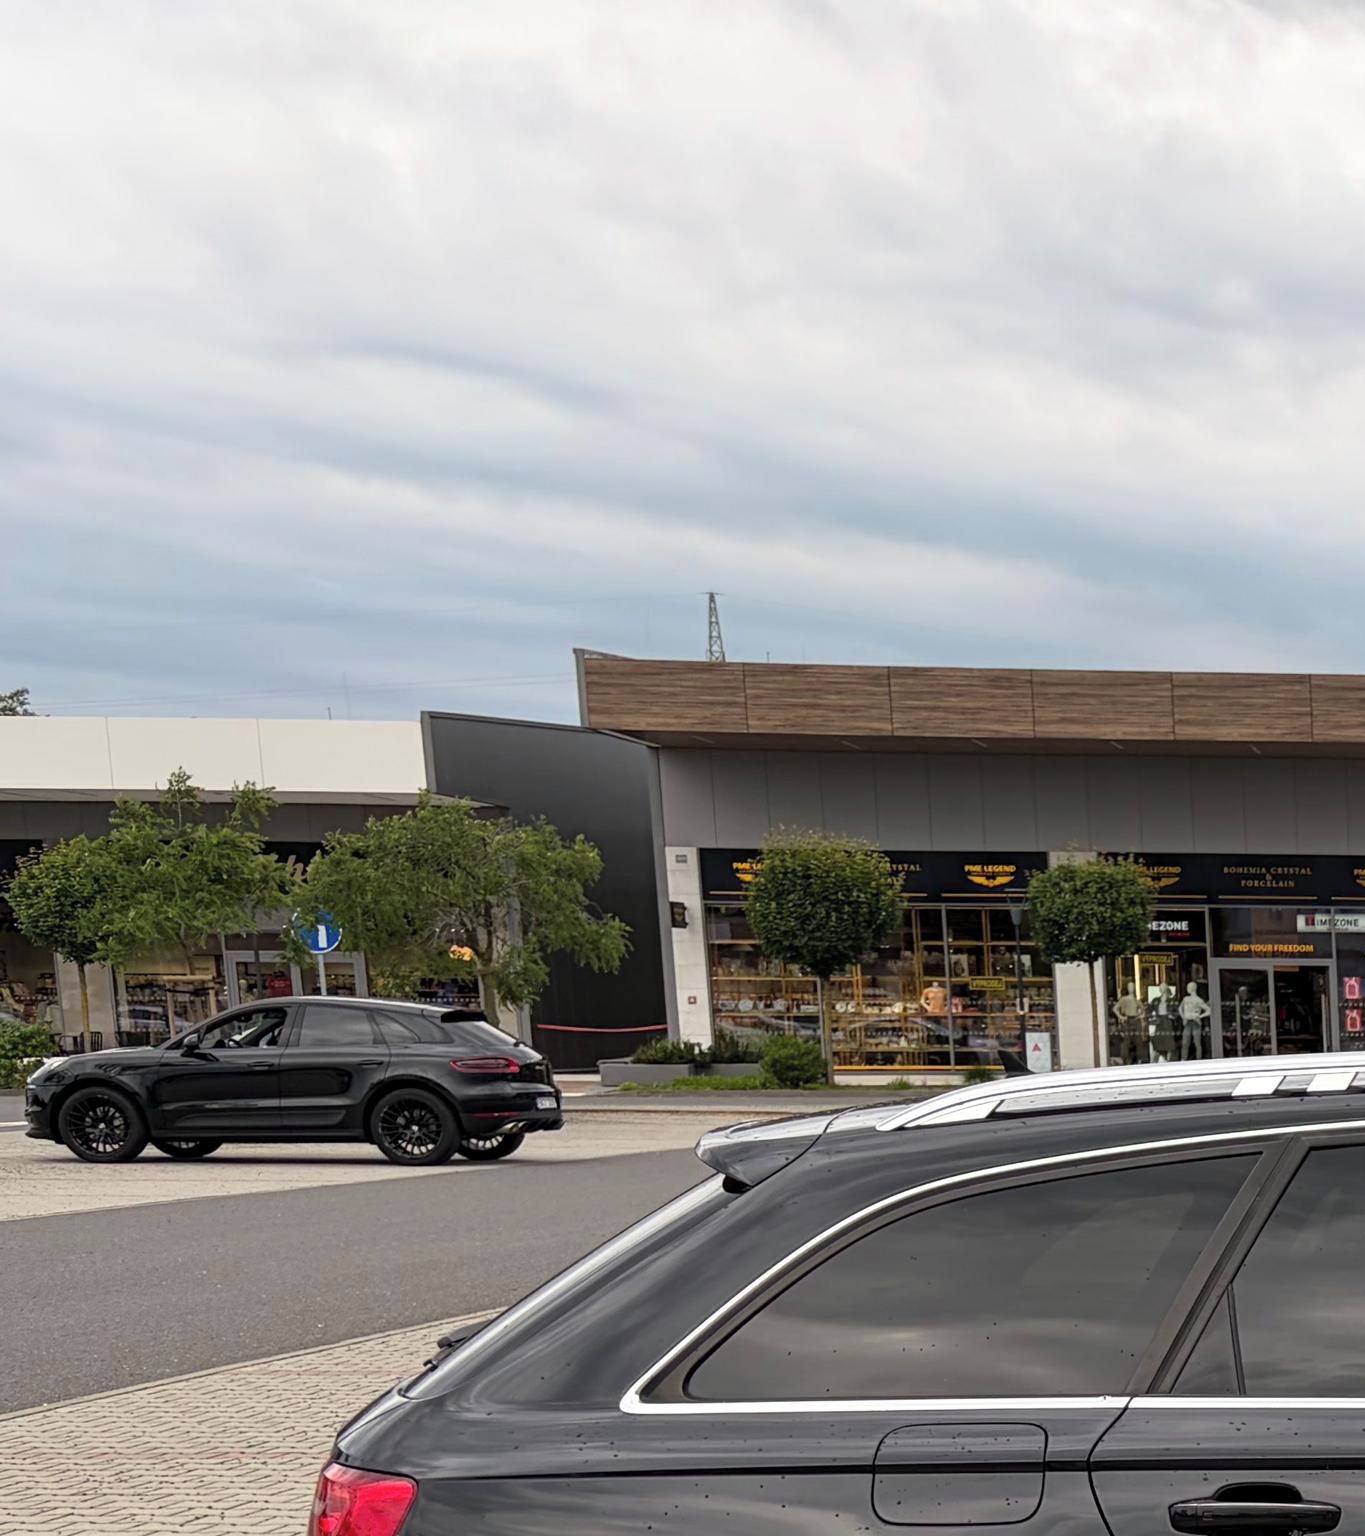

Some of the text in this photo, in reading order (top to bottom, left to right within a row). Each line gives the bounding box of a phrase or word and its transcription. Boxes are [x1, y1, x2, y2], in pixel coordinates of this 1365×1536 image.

[964, 864, 1016, 873] PME LEGEND
[1224, 866, 1312, 876] BOHEMIA CRYSTAL
[1241, 879, 1295, 888] PORCELAIN
[1229, 943, 1314, 953] FIND YOUR FREEDOM
